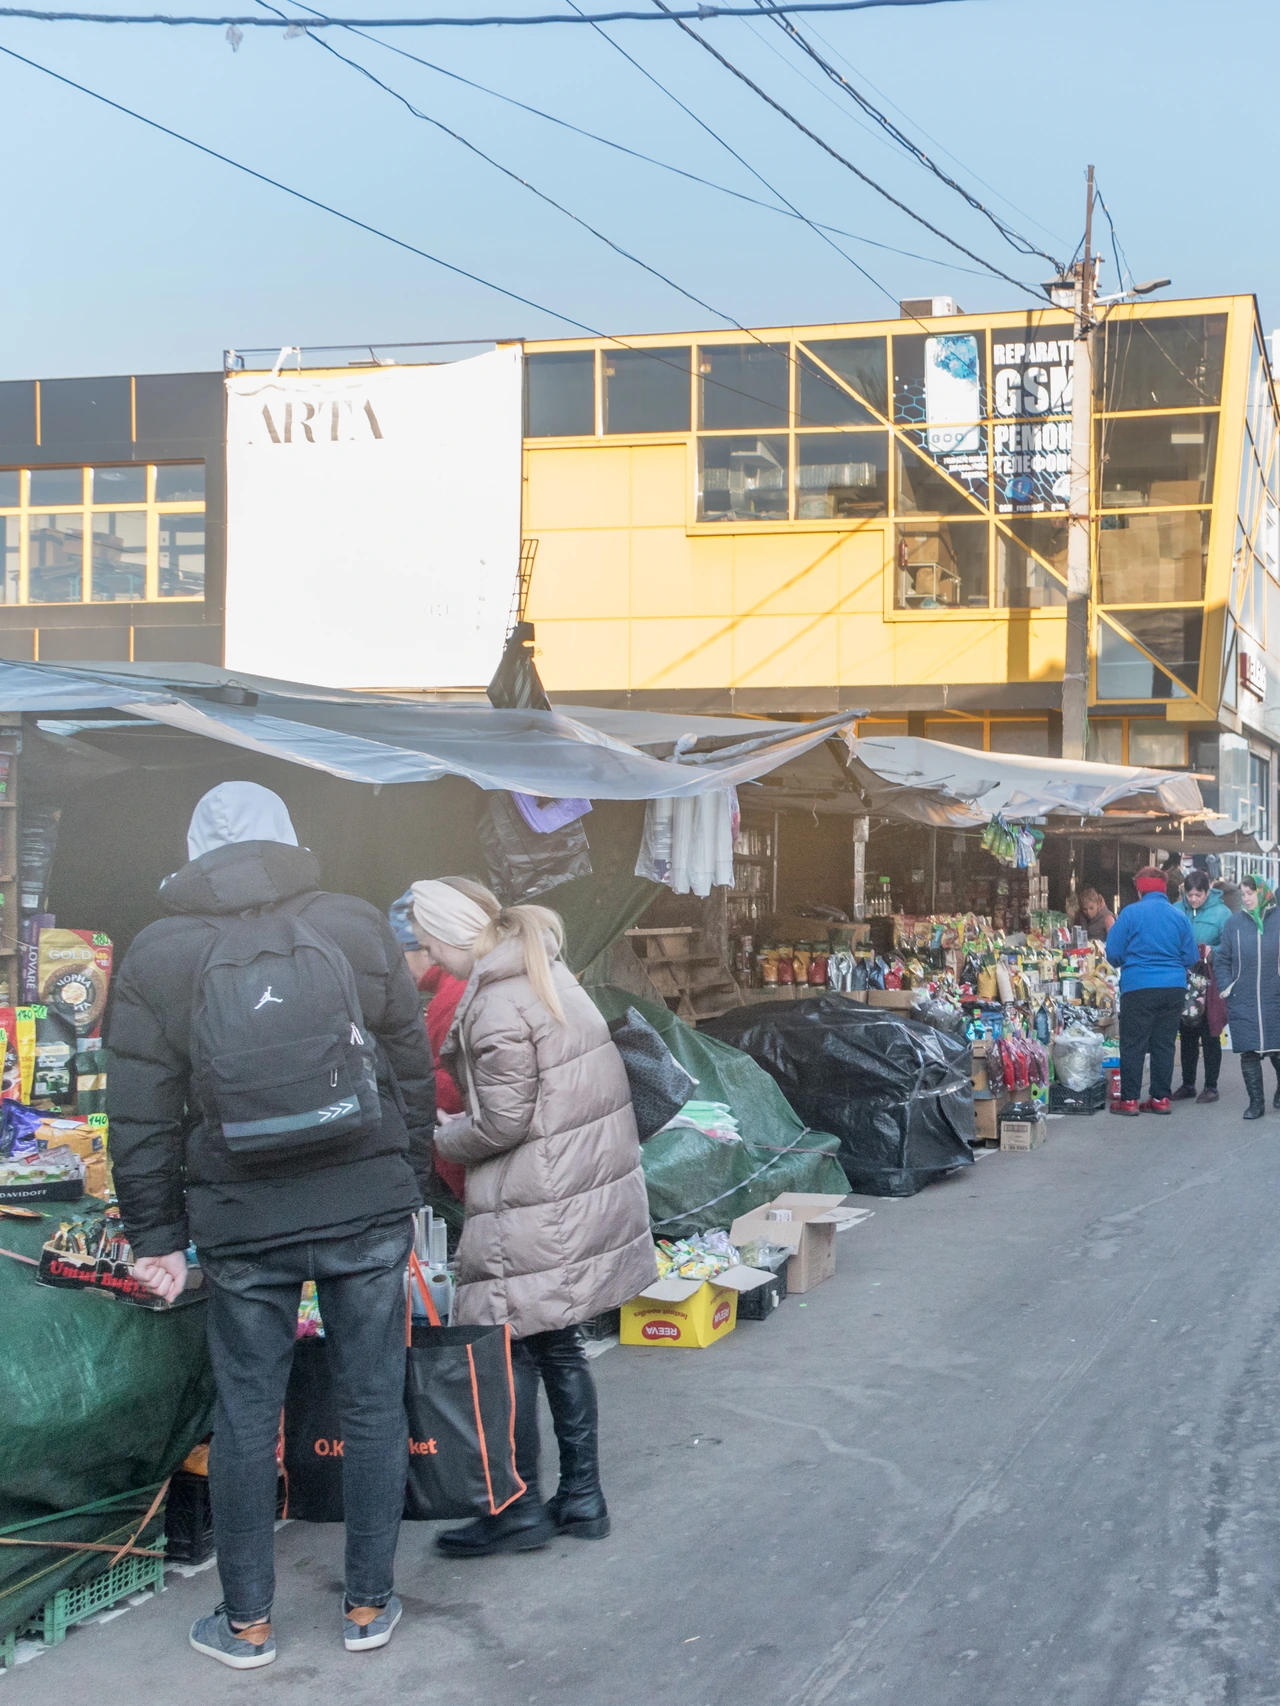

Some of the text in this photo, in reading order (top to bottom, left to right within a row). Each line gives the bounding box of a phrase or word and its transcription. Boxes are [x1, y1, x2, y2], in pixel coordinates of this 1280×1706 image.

[247, 398, 384, 445] ARTA
[994, 453, 1072, 475] ТЕЛЕФОН
[48, 949, 92, 960] GOLD
[26, 946, 38, 990] LOVARÉ
[56, 973, 92, 988] ЧОРНА
[0, 1189, 48, 1198] DAVIDOFF
[50, 1260, 97, 1283] Umut
[713, 1307, 731, 1322] REEVA
[645, 1325, 678, 1336] REEVA
